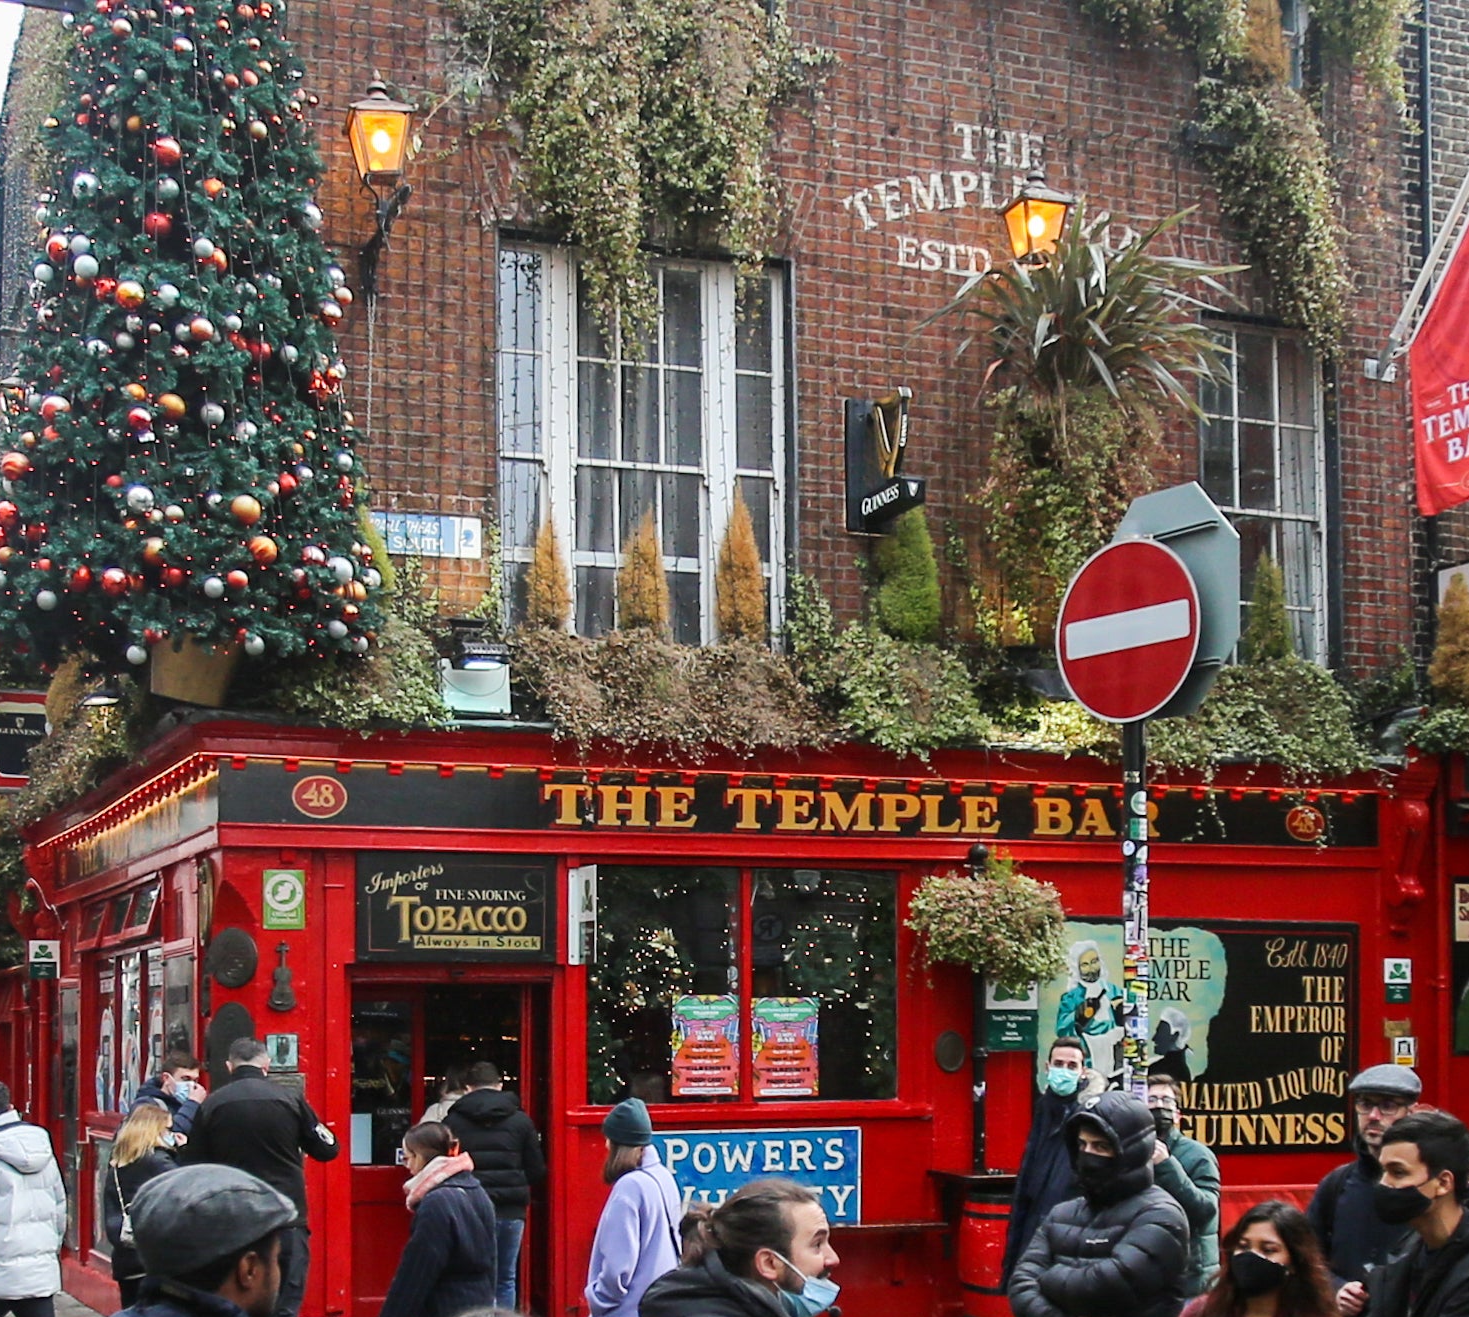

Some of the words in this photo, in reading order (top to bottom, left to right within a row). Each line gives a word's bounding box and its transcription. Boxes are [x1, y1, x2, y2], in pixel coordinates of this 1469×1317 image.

[954, 123, 1045, 169] THE
[861, 483, 900, 516] GUINNESS
[393, 535, 444, 551] SOUTH
[461, 529, 474, 548] 2
[301, 782, 335, 808] 48
[544, 783, 698, 829] THE
[727, 788, 1003, 834] TEMPLE
[365, 863, 444, 895] Importers
[414, 881, 429, 892] OF
[436, 889, 465, 901] FINE
[468, 889, 527, 902] SMOKING
[416, 936, 469, 949] Always
[477, 936, 490, 947] in
[497, 936, 539, 948] Stock
[1147, 938, 1191, 959] THE
[1312, 942, 1349, 969] 1840
[1150, 960, 1211, 980] MPLE
[1147, 981, 1192, 1002] BAR
[1302, 976, 1345, 1003] THE
[1250, 1005, 1346, 1034] EMPEROR
[1320, 1036, 1345, 1064] OF
[1179, 1081, 1263, 1112] MALTED
[1266, 1066, 1350, 1105] LIQUORS
[663, 1138, 845, 1175] POWER'S
